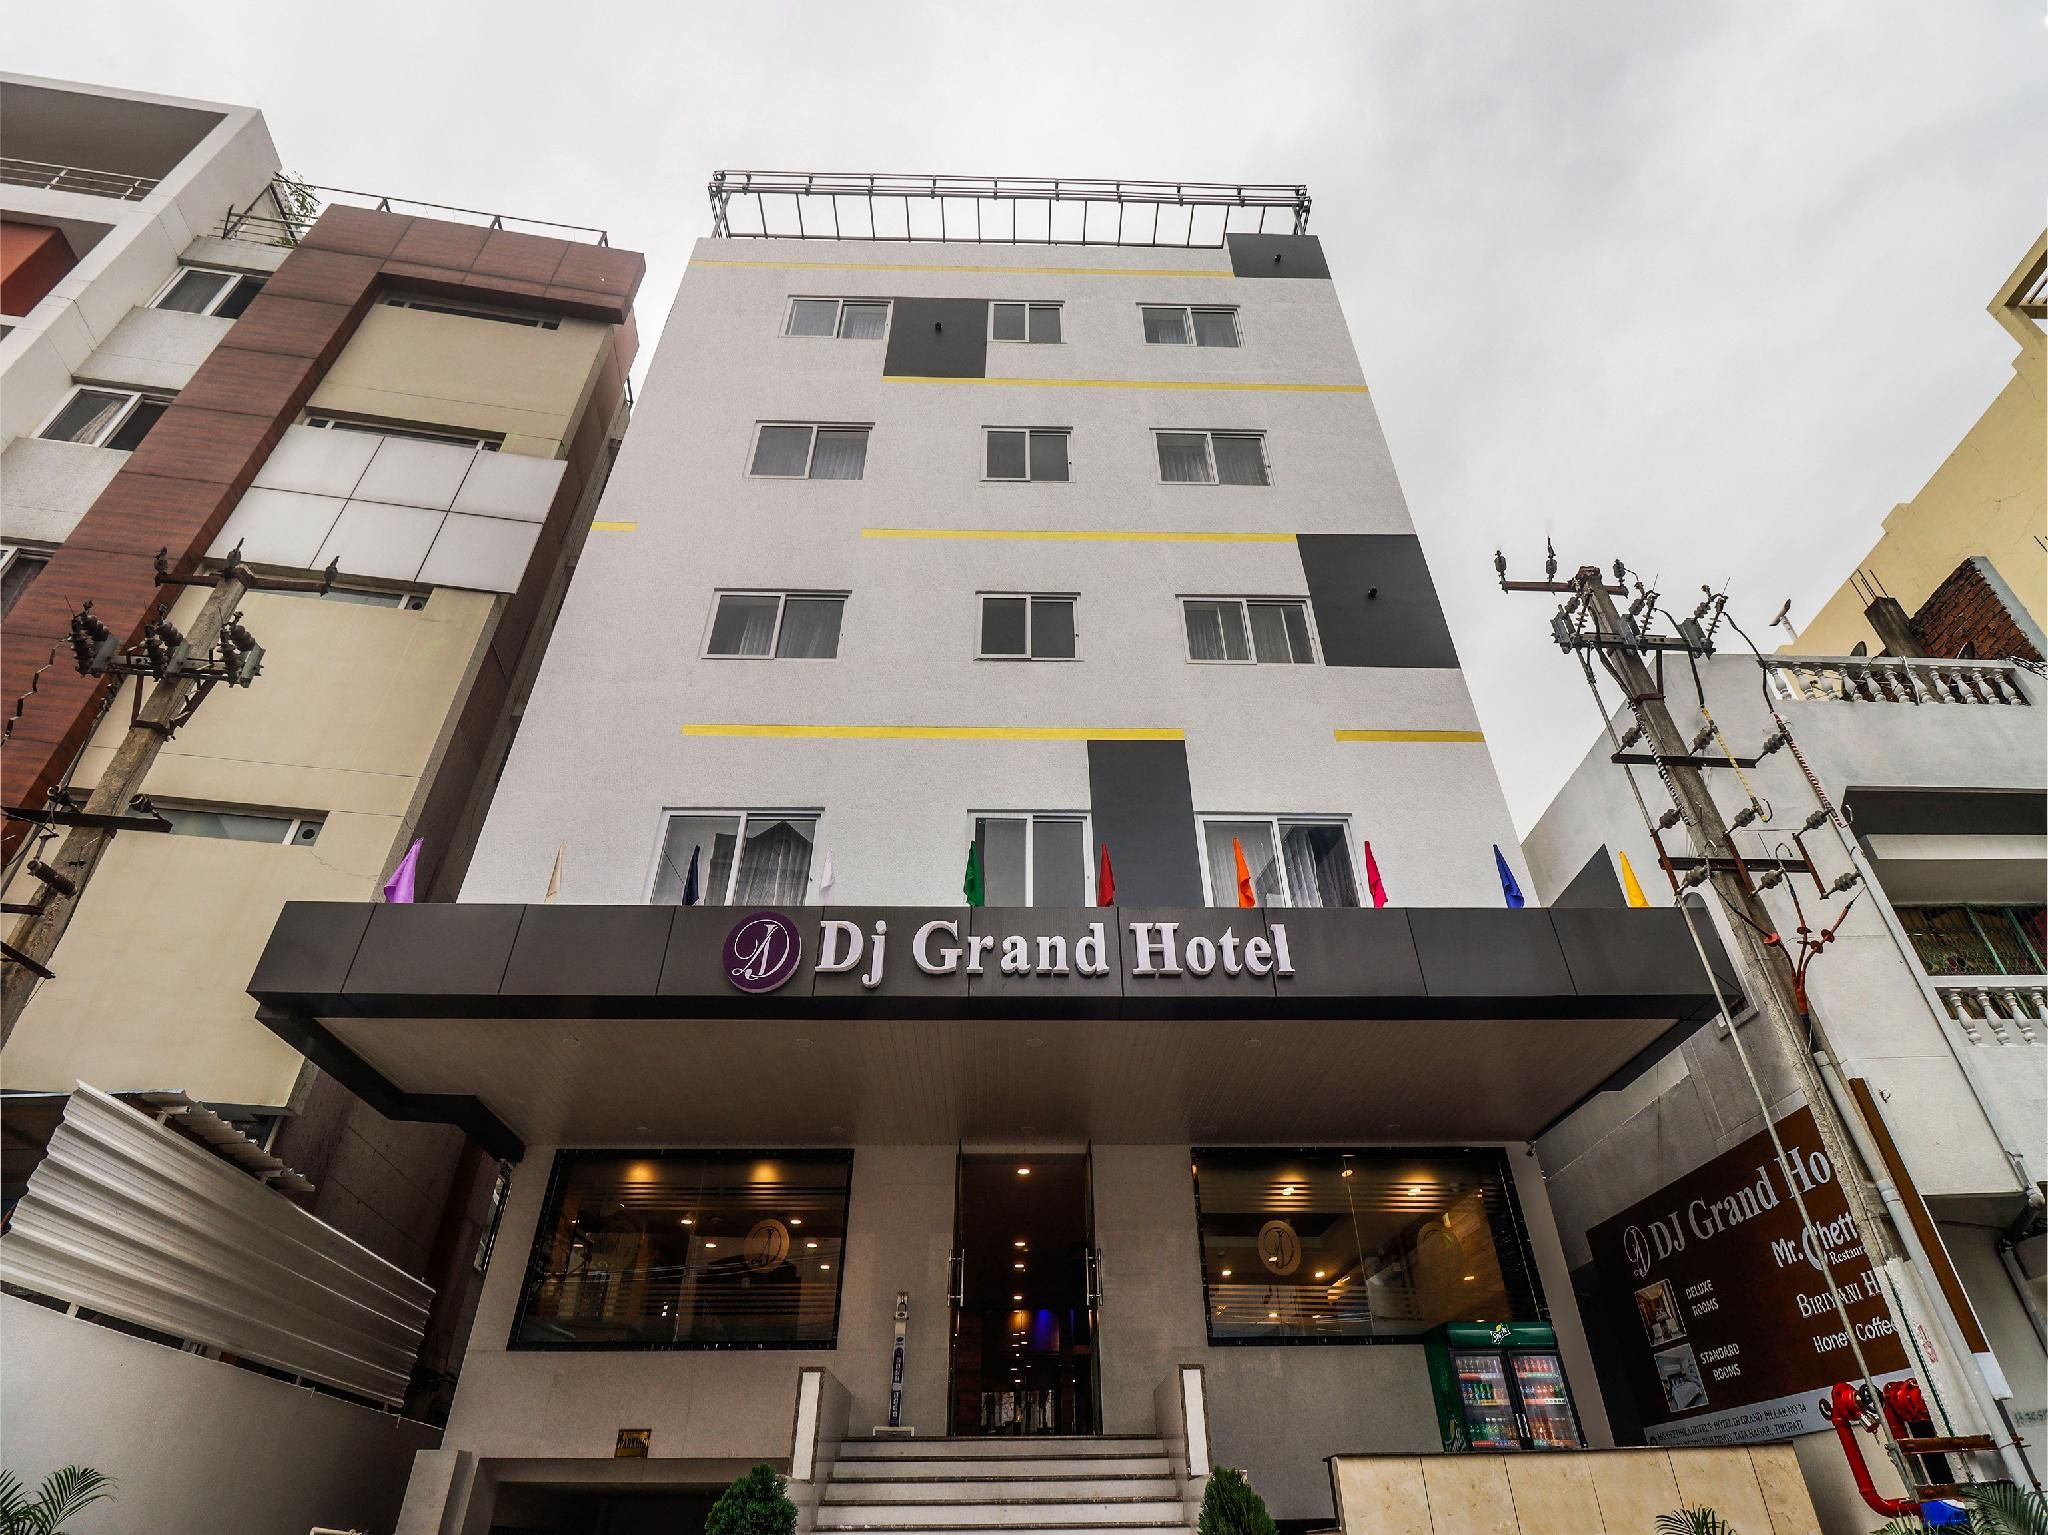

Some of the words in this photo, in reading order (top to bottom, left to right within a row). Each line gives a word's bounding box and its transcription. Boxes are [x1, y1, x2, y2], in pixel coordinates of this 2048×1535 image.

[814, 920, 887, 988] Dj
[912, 920, 1110, 977] Grand
[1129, 922, 1296, 977] Hotel
[1648, 1210, 1686, 1260] DJ
[1688, 1165, 1781, 1240] Grand
[1774, 1146, 1833, 1199] Ho
[1770, 1238, 1804, 1268] Mr.
[1801, 1211, 1859, 1271] Chett
[1685, 1279, 1714, 1300] DELUXE
[1860, 1269, 1883, 1297] H
[1691, 1297, 1719, 1317] ROOMS
[1699, 1342, 1740, 1365] STANDARD
[1712, 1363, 1741, 1381] ROOMS
[1740, 1412, 1763, 1425] GRAND
[1763, 1407, 1788, 1421] PILLAR
